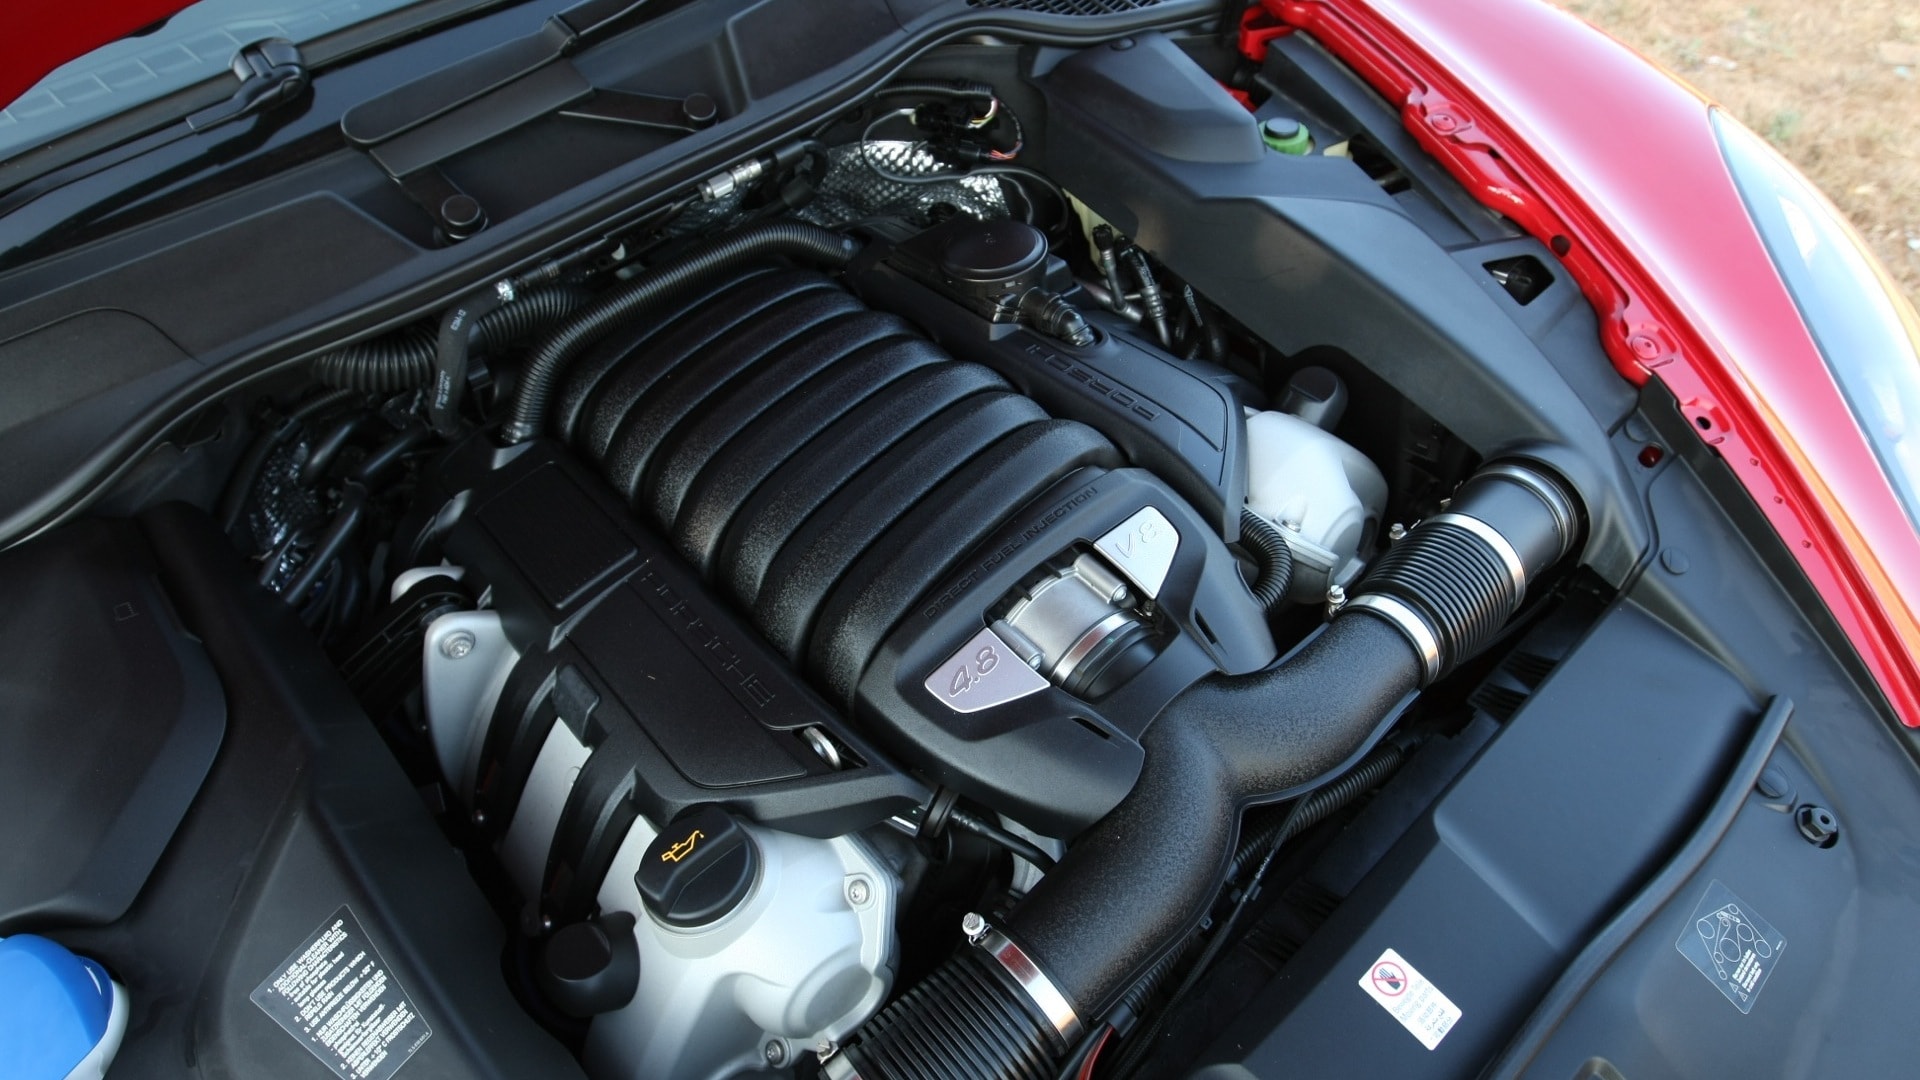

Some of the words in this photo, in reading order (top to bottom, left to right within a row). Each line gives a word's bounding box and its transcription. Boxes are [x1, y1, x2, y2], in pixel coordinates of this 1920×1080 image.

[1020, 339, 1160, 423] PORSCH
[922, 569, 980, 620] DIRECT
[980, 537, 1022, 573] FUEL
[1022, 484, 1098, 542] INJECTION
[1115, 520, 1155, 558] V8
[949, 645, 999, 696] 4.8
[272, 973, 288, 988] ONLY
[285, 962, 299, 975] USE
[329, 918, 344, 931] AND
[327, 928, 342, 942] WITH
[281, 969, 309, 996] FOLLOWING
[314, 989, 326, 1001] USE
[323, 965, 350, 992] PRODUCTS
[347, 950, 365, 967] WHICH
[371, 968, 384, 980] UND
[303, 1002, 323, 1021] REPELS
[309, 1016, 321, 1028] USE
[318, 992, 345, 1018] ANTIFREEZE
[342, 976, 360, 994] BELOW
